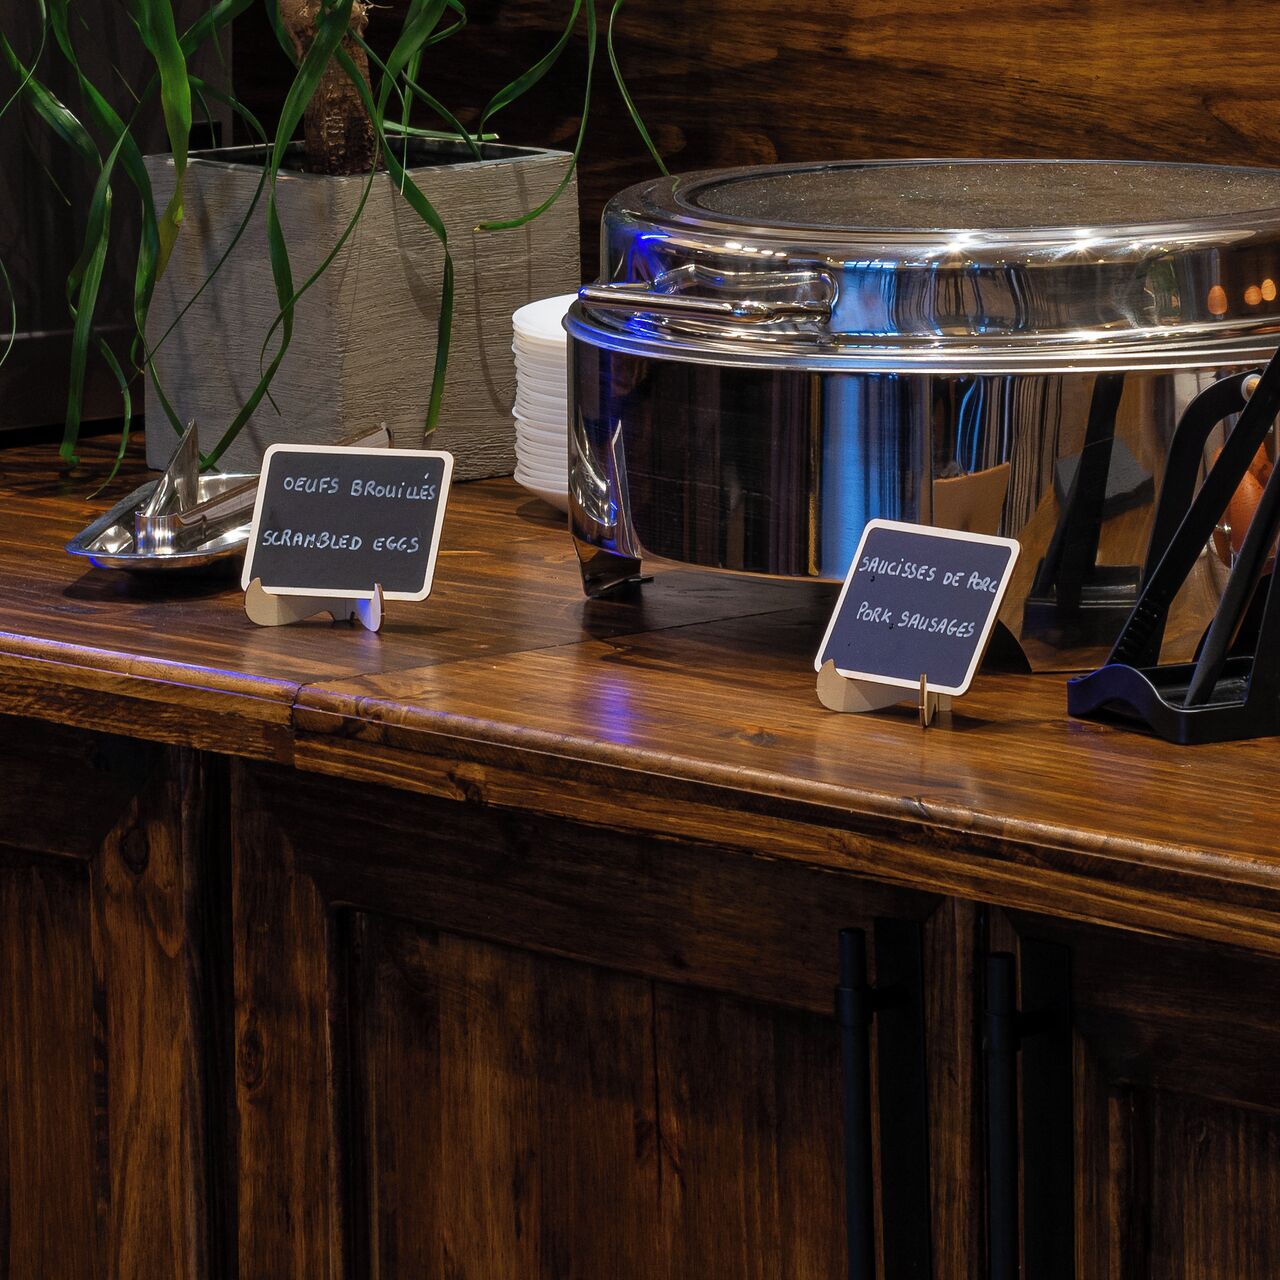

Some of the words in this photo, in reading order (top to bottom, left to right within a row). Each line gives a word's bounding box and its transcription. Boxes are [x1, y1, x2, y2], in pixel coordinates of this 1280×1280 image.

[283, 476, 340, 494] OEUFS
[262, 528, 363, 551] SCRAMBLED
[372, 536, 420, 553] EGGS
[942, 571, 965, 587] DE
[966, 571, 998, 593] PORC
[856, 601, 893, 624] PORK
[897, 610, 976, 638] SAUSAGES
